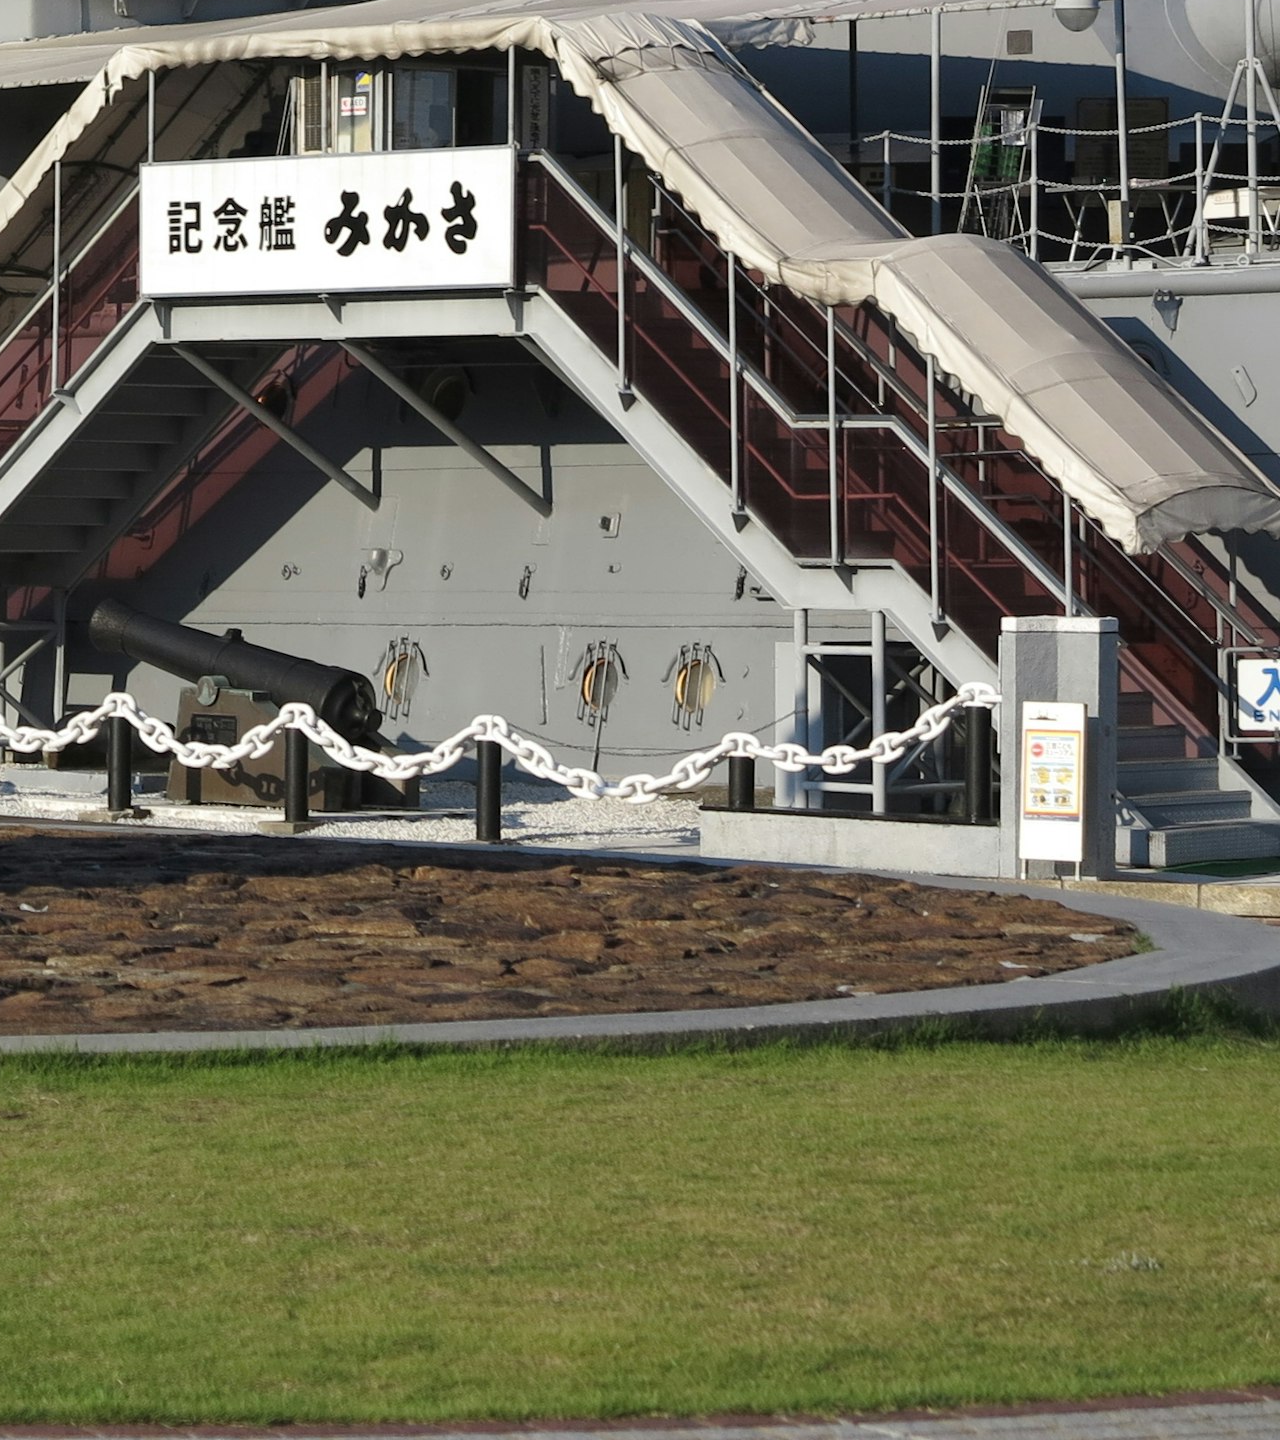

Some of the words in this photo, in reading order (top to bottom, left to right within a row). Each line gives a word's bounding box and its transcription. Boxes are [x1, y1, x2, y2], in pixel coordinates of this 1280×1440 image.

[166, 195, 297, 255] 記念艦
[323, 180, 478, 257] みかさ
